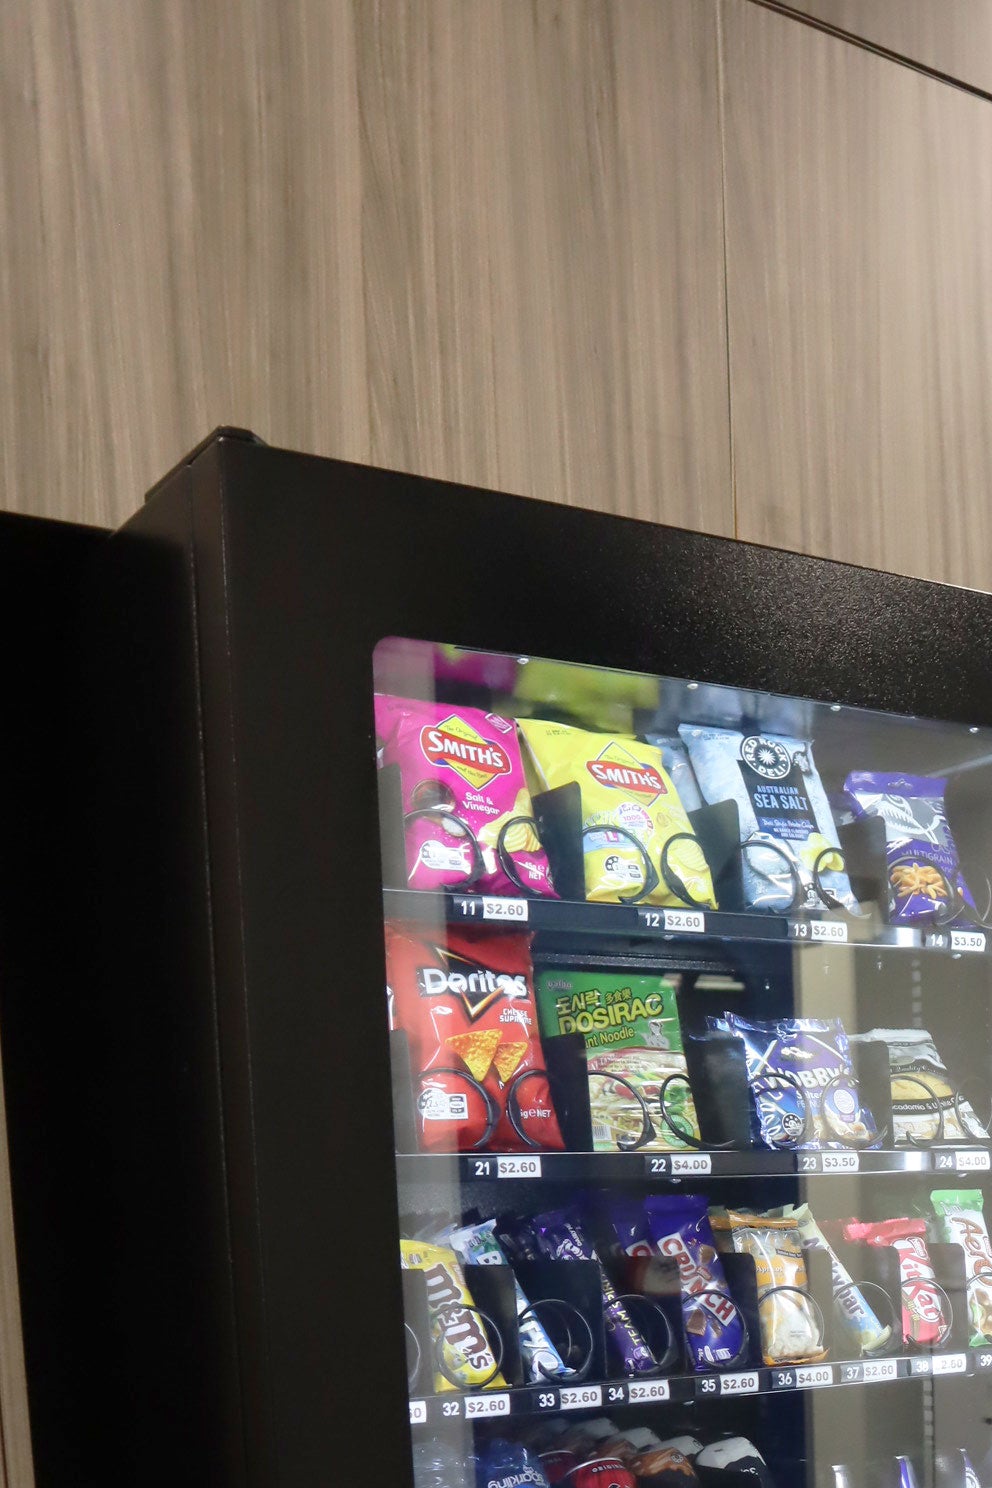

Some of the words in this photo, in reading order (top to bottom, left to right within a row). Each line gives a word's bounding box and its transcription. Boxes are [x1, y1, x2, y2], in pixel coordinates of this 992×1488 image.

[428, 730, 503, 767] SMITH'S
[745, 739, 757, 761] RED
[591, 764, 661, 790] SMITH'S
[758, 765, 786, 777] DELI
[756, 785, 799, 795] AUSTRALIAN
[465, 791, 484, 803] Salt
[486, 797, 494, 805] &
[754, 793, 779, 809] SEA
[780, 795, 808, 811] SALT
[462, 801, 500, 815] Vinegar
[461, 900, 476, 915] 11
[486, 901, 525, 916] $2.60
[645, 912, 659, 928] 12
[667, 915, 701, 928] $2.60
[793, 924, 807, 937] 13
[814, 925, 845, 938] $2.60
[930, 933, 944, 947] 14
[954, 936, 983, 948] $3.50
[422, 968, 528, 996] Doritos
[559, 993, 664, 1035] DOSIRAC
[600, 1025, 636, 1046] Noodle
[475, 1161, 490, 1176] 21
[499, 1162, 537, 1175] $2.60
[651, 1158, 667, 1172] 22
[674, 1158, 708, 1171] $4.00
[803, 1156, 817, 1169] 23
[825, 1157, 856, 1169] $3.50
[939, 1156, 953, 1168] 24
[958, 1156, 987, 1167] $4.00
[935, 1358, 963, 1371] 2.60
[980, 1354, 992, 1367] 39
[778, 1372, 792, 1385] 36
[798, 1371, 829, 1384] $4.00
[847, 1367, 859, 1379] 37
[865, 1365, 895, 1377] $2.60
[702, 1379, 716, 1392] 35
[723, 1377, 755, 1390] $2.60
[539, 1393, 556, 1407] 33
[561, 1391, 598, 1405] $2.60
[609, 1387, 625, 1401] 34
[630, 1385, 666, 1399] $2.60
[443, 1401, 460, 1417] 32
[467, 1399, 506, 1413] $2.60
